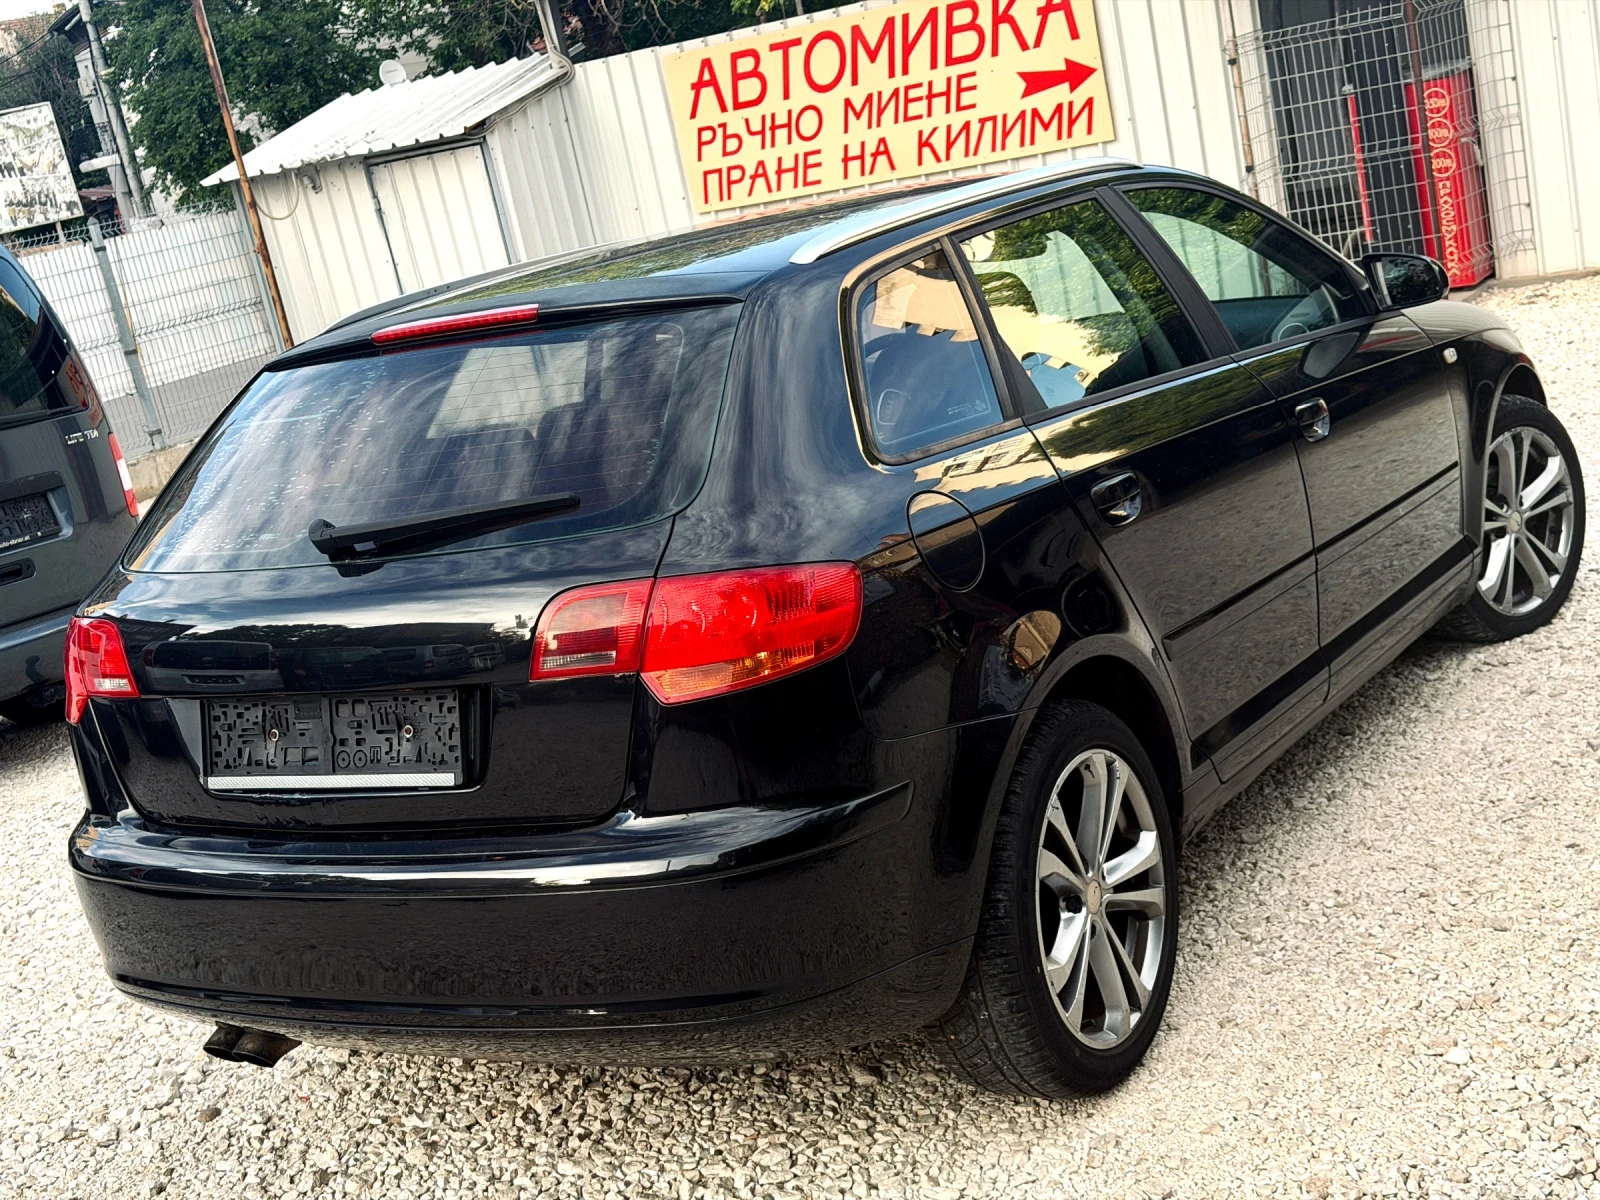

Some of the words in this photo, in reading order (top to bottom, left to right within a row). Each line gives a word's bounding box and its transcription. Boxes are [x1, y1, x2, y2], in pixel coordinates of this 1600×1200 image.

[690, 0, 1080, 120] АВТОМИВКА
[698, 104, 822, 162] РЪЧНО
[843, 72, 977, 134] МИЕНЕ
[704, 149, 822, 205] ПРАНЕ
[842, 137, 896, 180] НА
[918, 96, 1094, 167] КИЛИМИ
